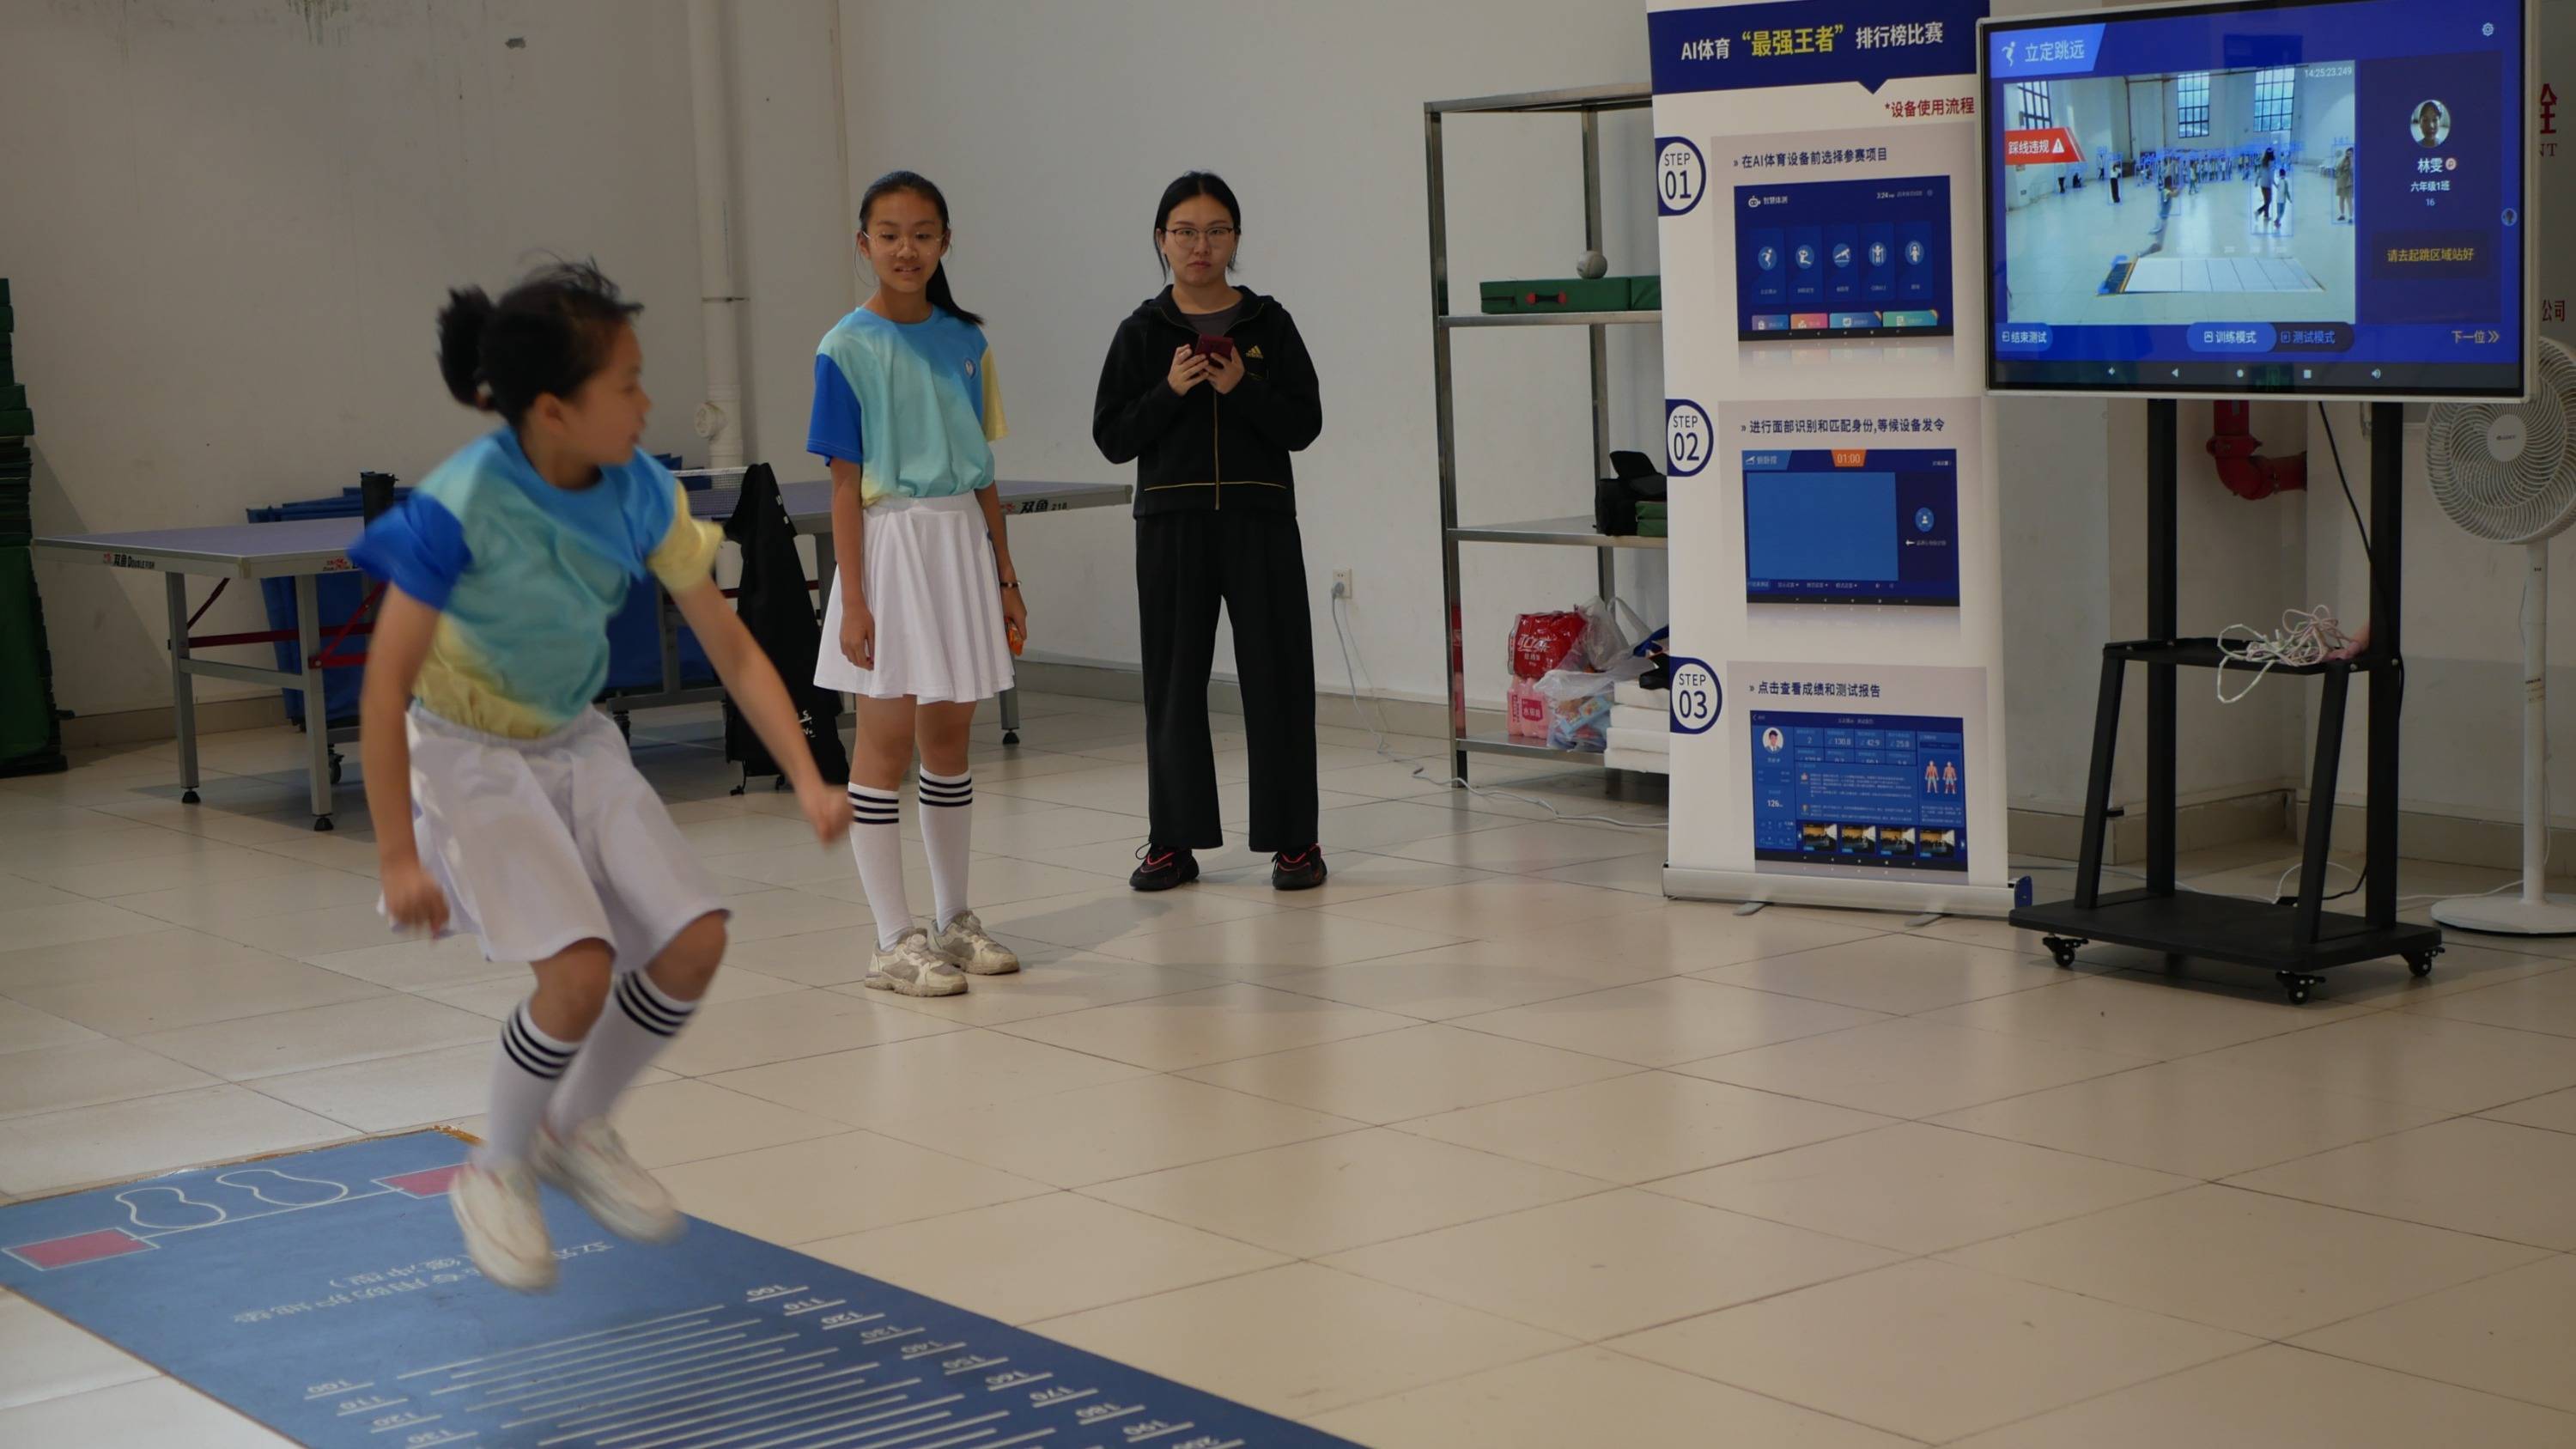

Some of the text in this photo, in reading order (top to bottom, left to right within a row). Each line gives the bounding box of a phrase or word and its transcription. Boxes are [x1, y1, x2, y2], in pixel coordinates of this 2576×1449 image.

[1681, 37, 1730, 61] AI体育
[1856, 21, 1944, 49] 排行榜比赛
[2025, 40, 2085, 63] 立定跳远
[2008, 138, 2050, 155] 踩线违规
[1664, 153, 1691, 166] STEP
[1741, 148, 1887, 169] 在AI体育设备前选择参赛项目
[2417, 158, 2443, 173] 林雯
[1665, 170, 1692, 200] 01
[2410, 180, 2451, 192] 六年级1班
[2387, 247, 2474, 263] 请去起跳区域站好
[2543, 299, 2565, 322] 公司
[2011, 331, 2047, 344] 结束测试
[2215, 330, 2257, 344] 训练模式
[2293, 331, 2336, 344] 测试模式
[2451, 331, 2485, 344] 下一位
[1674, 416, 1698, 429] STEP
[1674, 432, 1699, 461] 02
[1837, 454, 1861, 464] 01:00
[1020, 500, 1048, 514] 双鱼
[1679, 673, 1706, 686] STEP
[1758, 681, 1880, 698] 点击查看成绩和测试报告
[1680, 690, 1708, 720] 03
[747, 1285, 788, 1297] 100
[784, 1298, 825, 1311] 110
[821, 1311, 863, 1324] 120
[860, 1325, 902, 1338] 130
[901, 1340, 944, 1354] 140
[943, 1355, 987, 1369] 150
[985, 1370, 1030, 1385] 160
[307, 1379, 352, 1393] 100
[1030, 1386, 1074, 1402] 170
[339, 1396, 386, 1409] 110
[1075, 1403, 1121, 1418] 180
[373, 1411, 415, 1427] 120
[1122, 1420, 1169, 1435] 190
